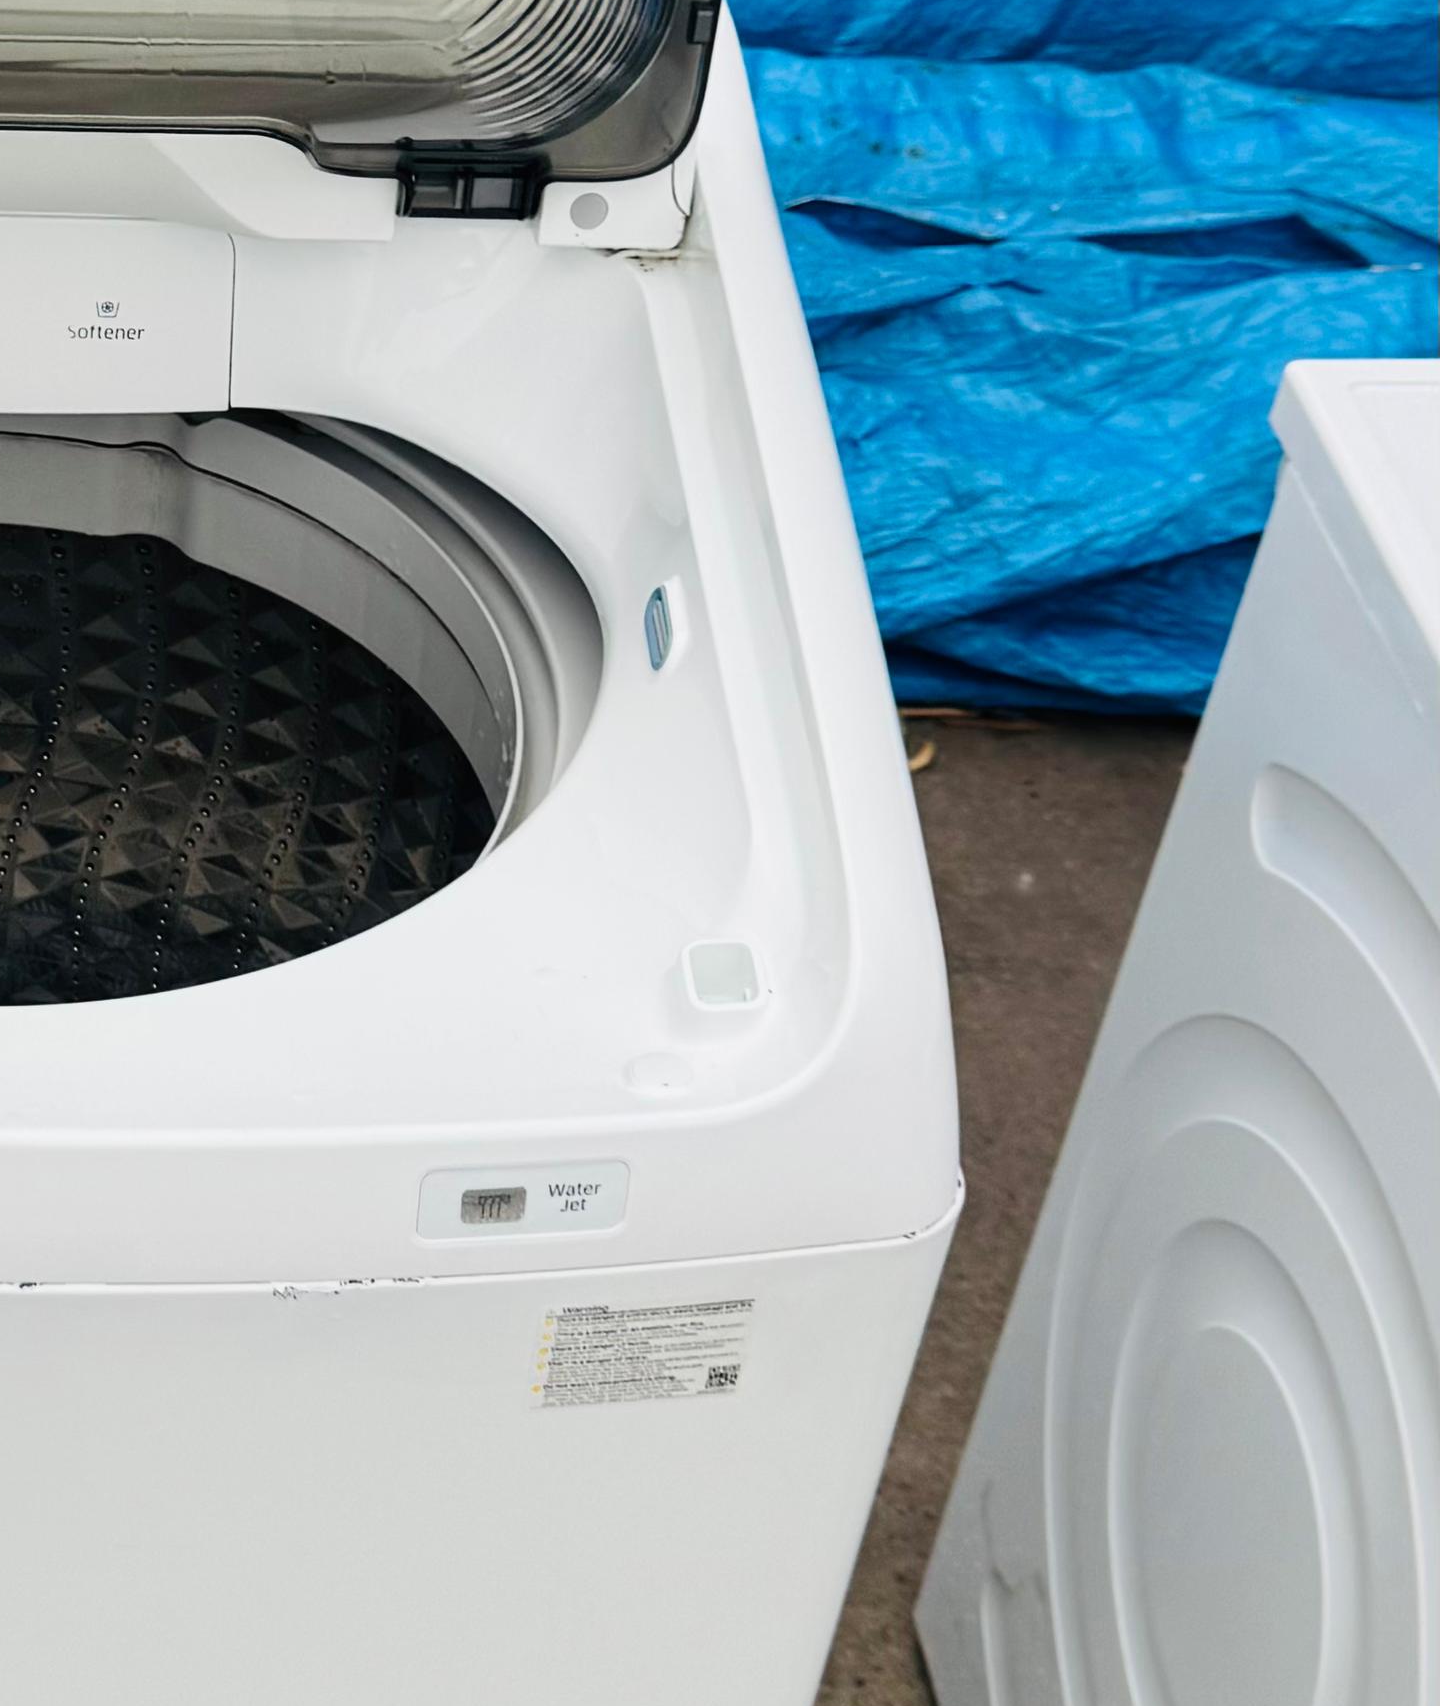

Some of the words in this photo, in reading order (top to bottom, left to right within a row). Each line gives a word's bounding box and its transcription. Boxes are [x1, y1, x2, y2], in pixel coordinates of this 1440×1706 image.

[67, 324, 146, 341] Softener
[547, 1181, 602, 1198] Water
[560, 1198, 587, 1213] Jet
